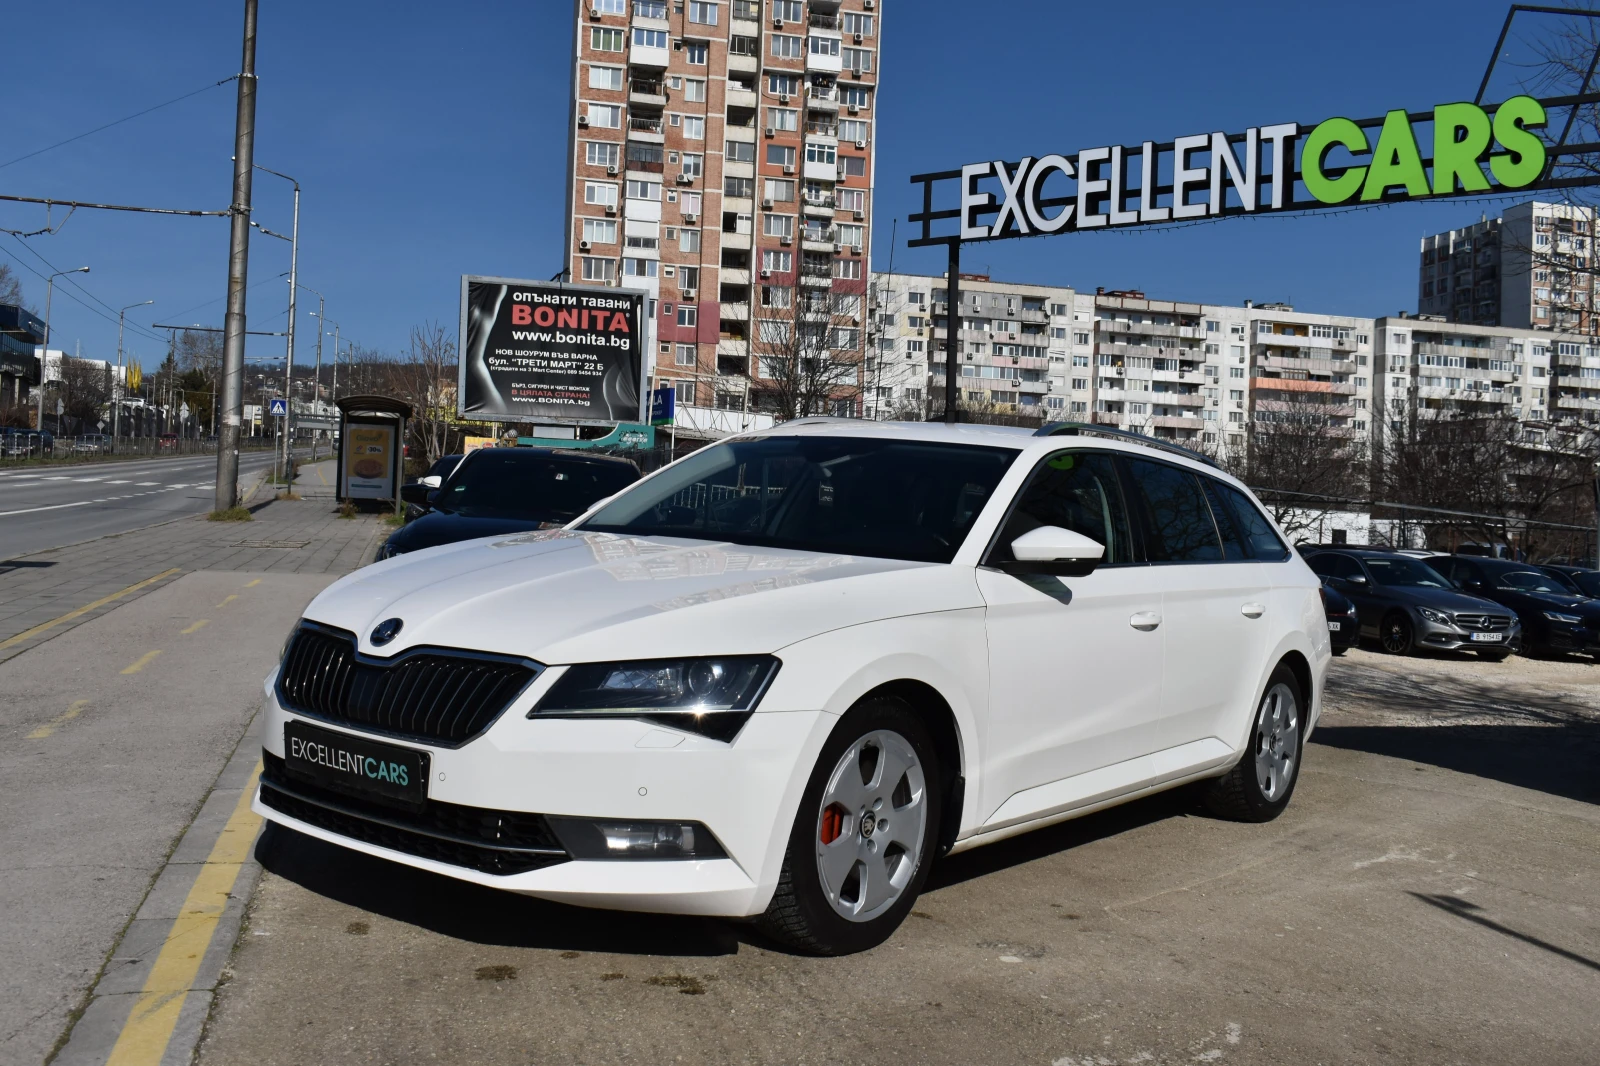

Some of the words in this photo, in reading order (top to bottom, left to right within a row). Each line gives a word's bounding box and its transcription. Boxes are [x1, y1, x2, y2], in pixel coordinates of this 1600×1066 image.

[513, 292, 577, 305] опънати
[581, 297, 630, 310] тавани
[512, 304, 630, 333] BONITA
[512, 331, 630, 350] www.bonita.bg
[515, 350, 549, 358] ШОУРУМ
[571, 353, 598, 361] ВАРНА
[488, 357, 509, 366] бул.
[584, 362, 595, 370] 22
[512, 397, 590, 407] www.BONITA.bg
